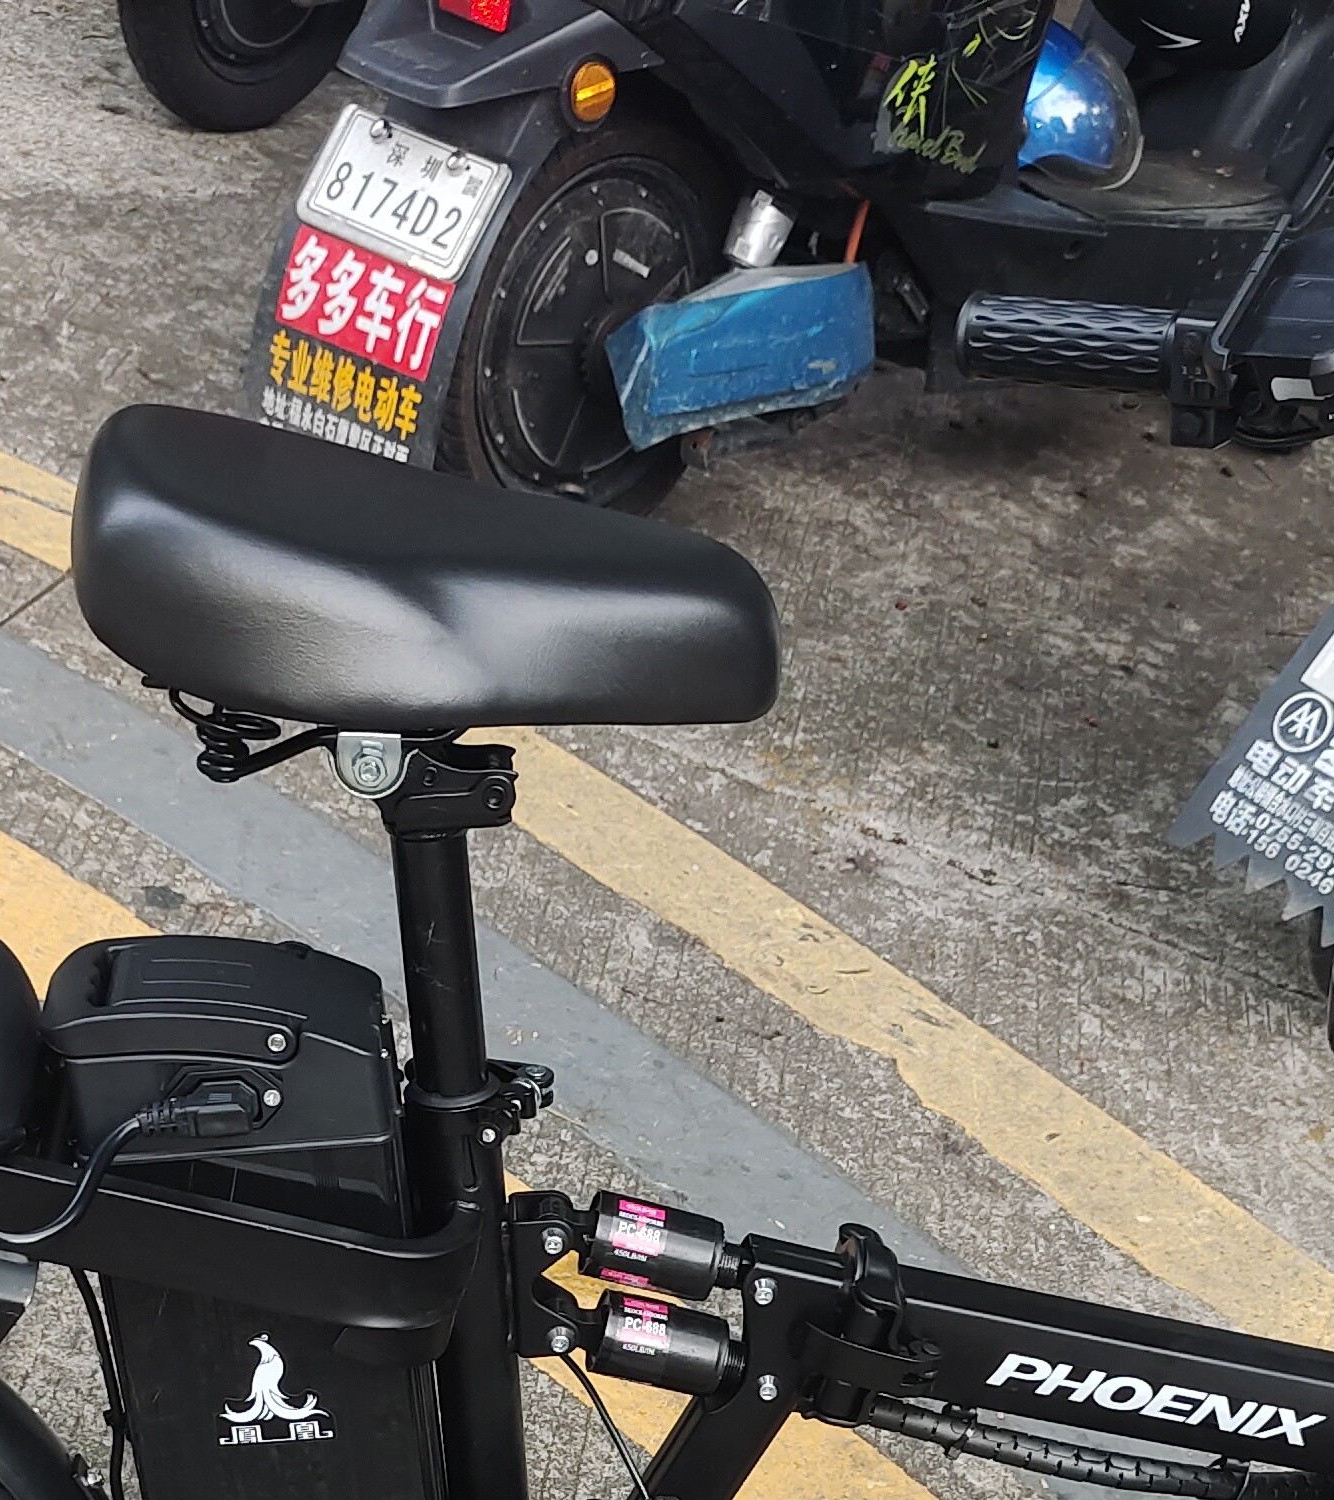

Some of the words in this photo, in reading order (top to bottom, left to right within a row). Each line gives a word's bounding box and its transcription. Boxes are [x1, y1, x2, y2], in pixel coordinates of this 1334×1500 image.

[325, 161, 463, 250] 8174D2
[386, 142, 444, 182] 深圳
[281, 234, 448, 372] 多多车行
[268, 328, 424, 441] 专业维修电动车
[985, 1353, 1328, 1447] PHOENIX
